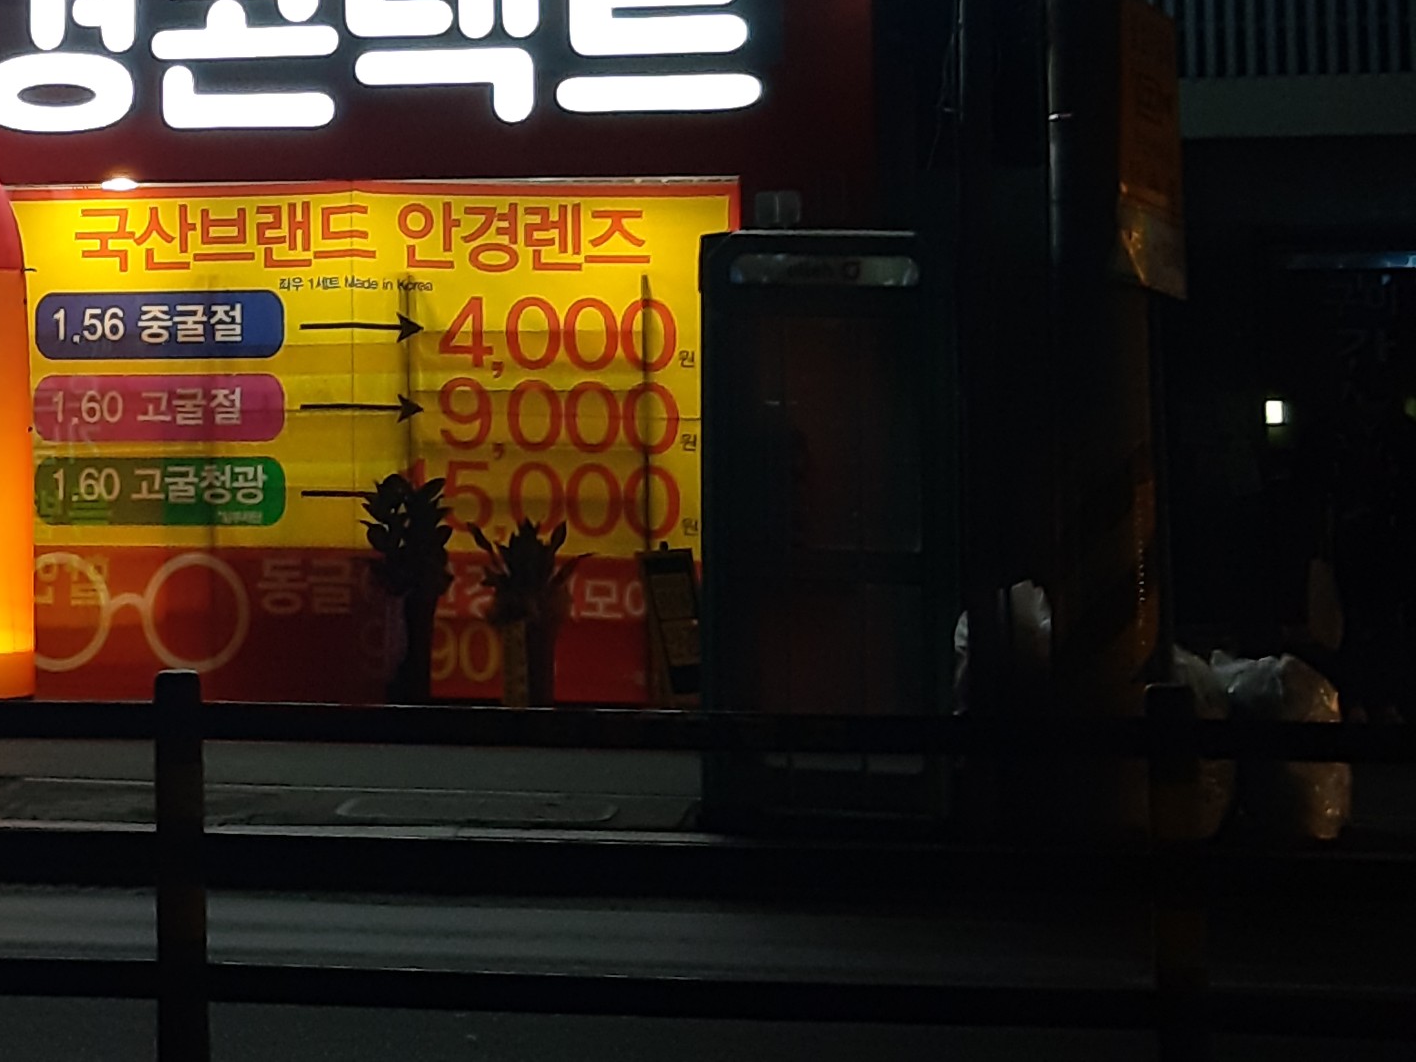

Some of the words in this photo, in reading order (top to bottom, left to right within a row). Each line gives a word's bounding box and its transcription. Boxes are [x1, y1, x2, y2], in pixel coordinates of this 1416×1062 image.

[74, 203, 377, 275] 국산브랜드
[396, 200, 653, 274] 안경렌즈
[345, 275, 379, 290] Made
[52, 306, 126, 344] 1.56
[136, 302, 244, 344] 중굴절
[438, 295, 678, 379] 4,000
[52, 390, 124, 426] 1.60
[136, 386, 243, 426] 고굴절
[438, 376, 680, 461] 9,000
[52, 467, 122, 503] 1.60
[131, 464, 268, 505] 고굴청광
[258, 557, 374, 615] 동글
